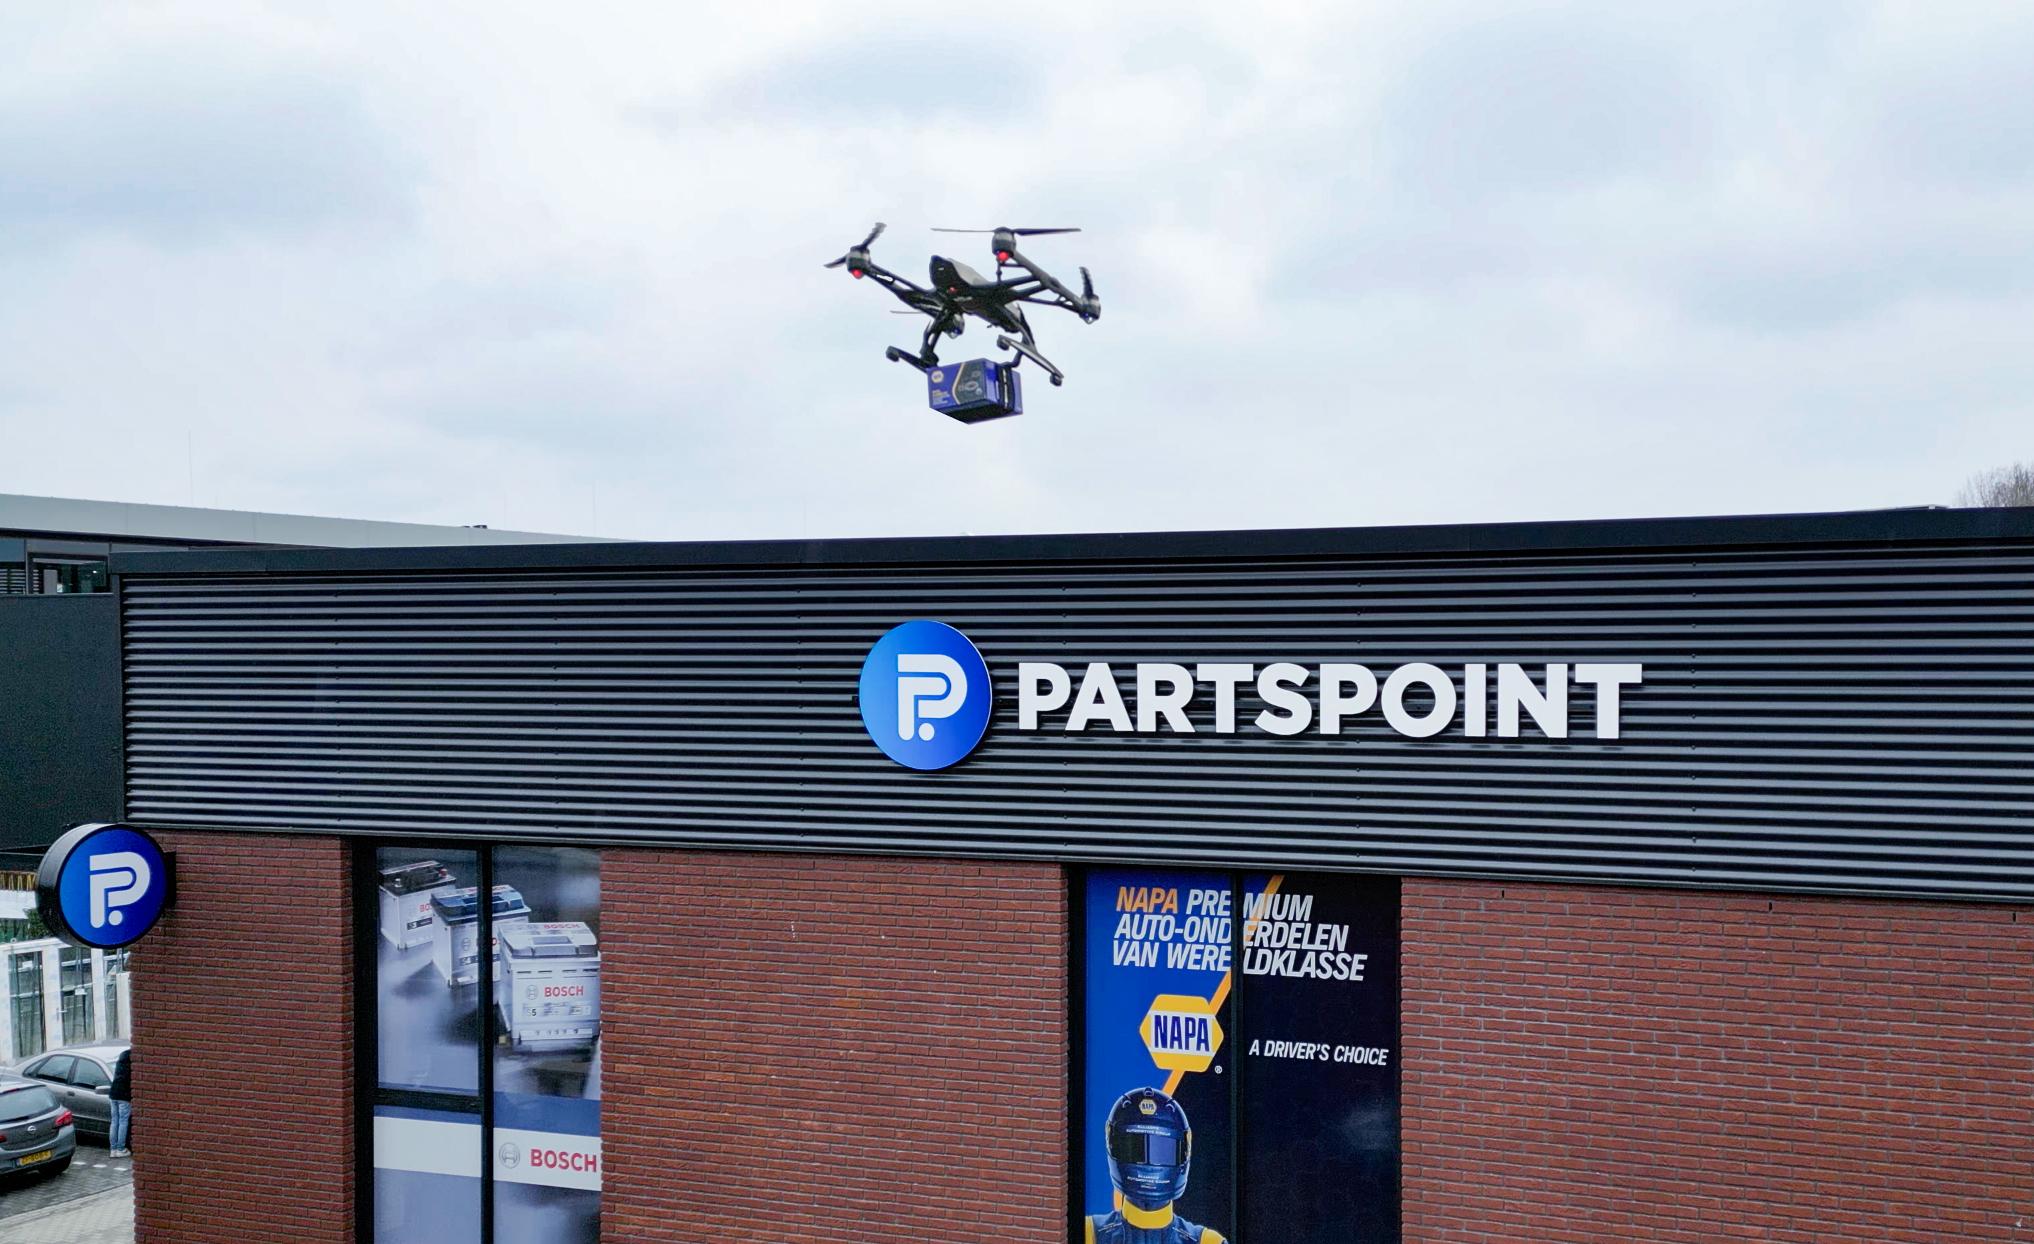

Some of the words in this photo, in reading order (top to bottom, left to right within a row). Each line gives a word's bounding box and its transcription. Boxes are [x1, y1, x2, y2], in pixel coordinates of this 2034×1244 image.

[1017, 661, 1643, 739] PARTSPOINT
[1116, 886, 1178, 914] NAPA
[1113, 940, 1160, 968] VAN
[543, 986, 584, 998] BOSCH
[1154, 1014, 1210, 1053] NAPA
[1249, 1039, 1260, 1057] A
[1264, 1040, 1330, 1062] DRIVER'S
[1333, 1047, 1390, 1067] CHOICE
[530, 1148, 597, 1173] BOSCH
